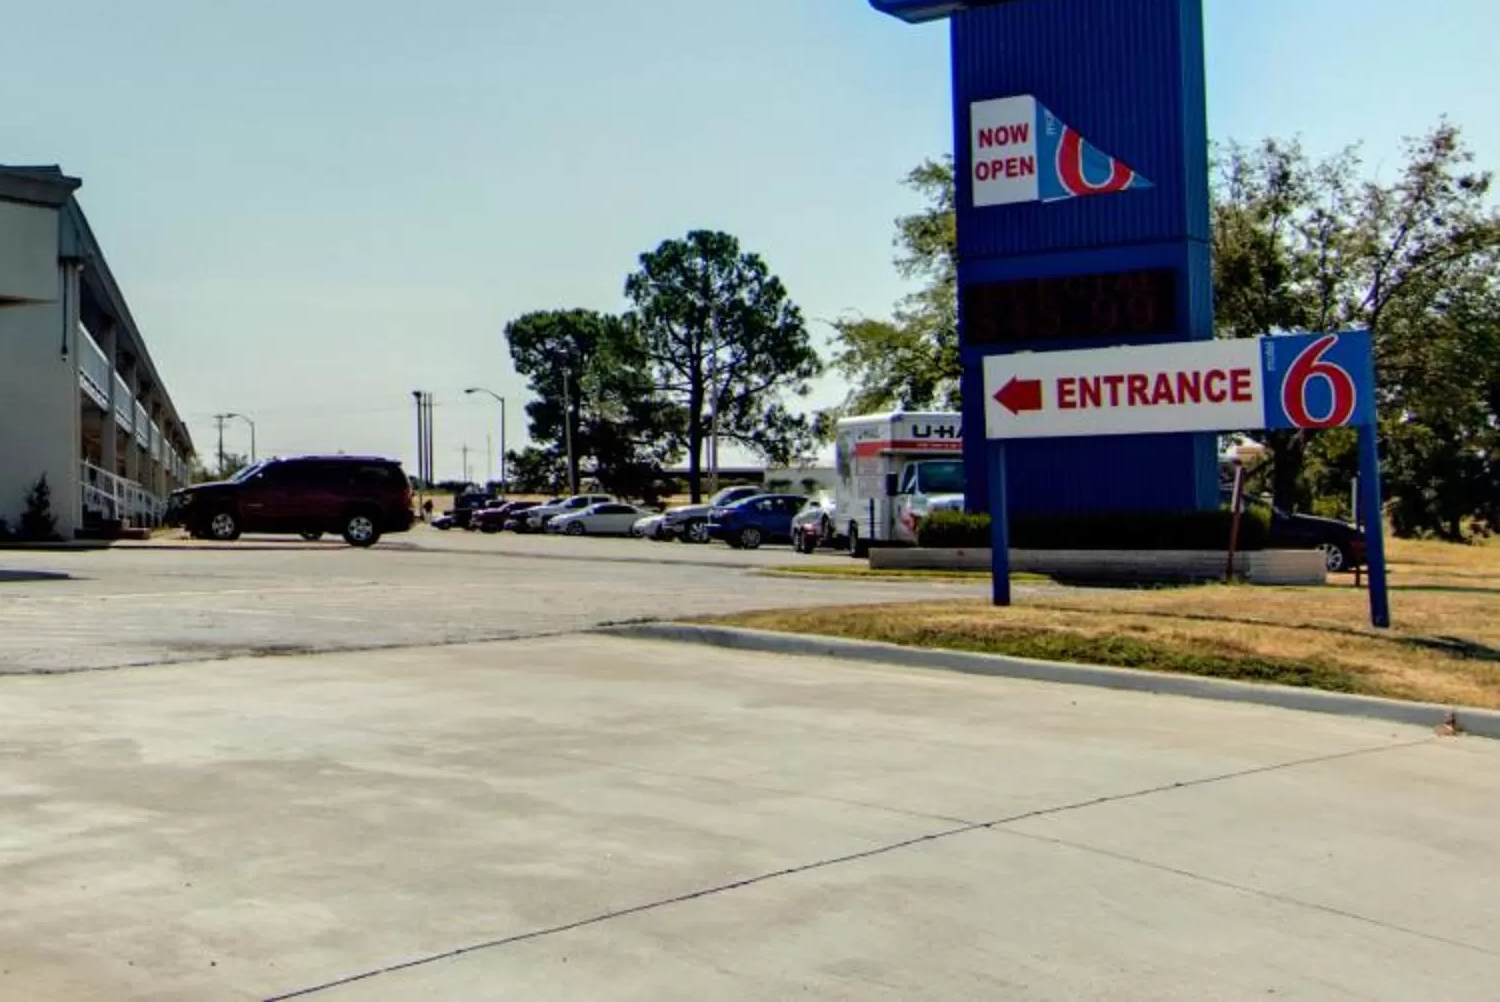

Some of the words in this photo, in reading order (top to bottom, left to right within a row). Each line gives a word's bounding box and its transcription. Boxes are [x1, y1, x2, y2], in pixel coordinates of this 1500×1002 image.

[978, 122, 1029, 148] NOW
[975, 155, 1035, 181] OPEN
[1056, 367, 1252, 409] ENTRANCE
[1281, 333, 1357, 428] 6
